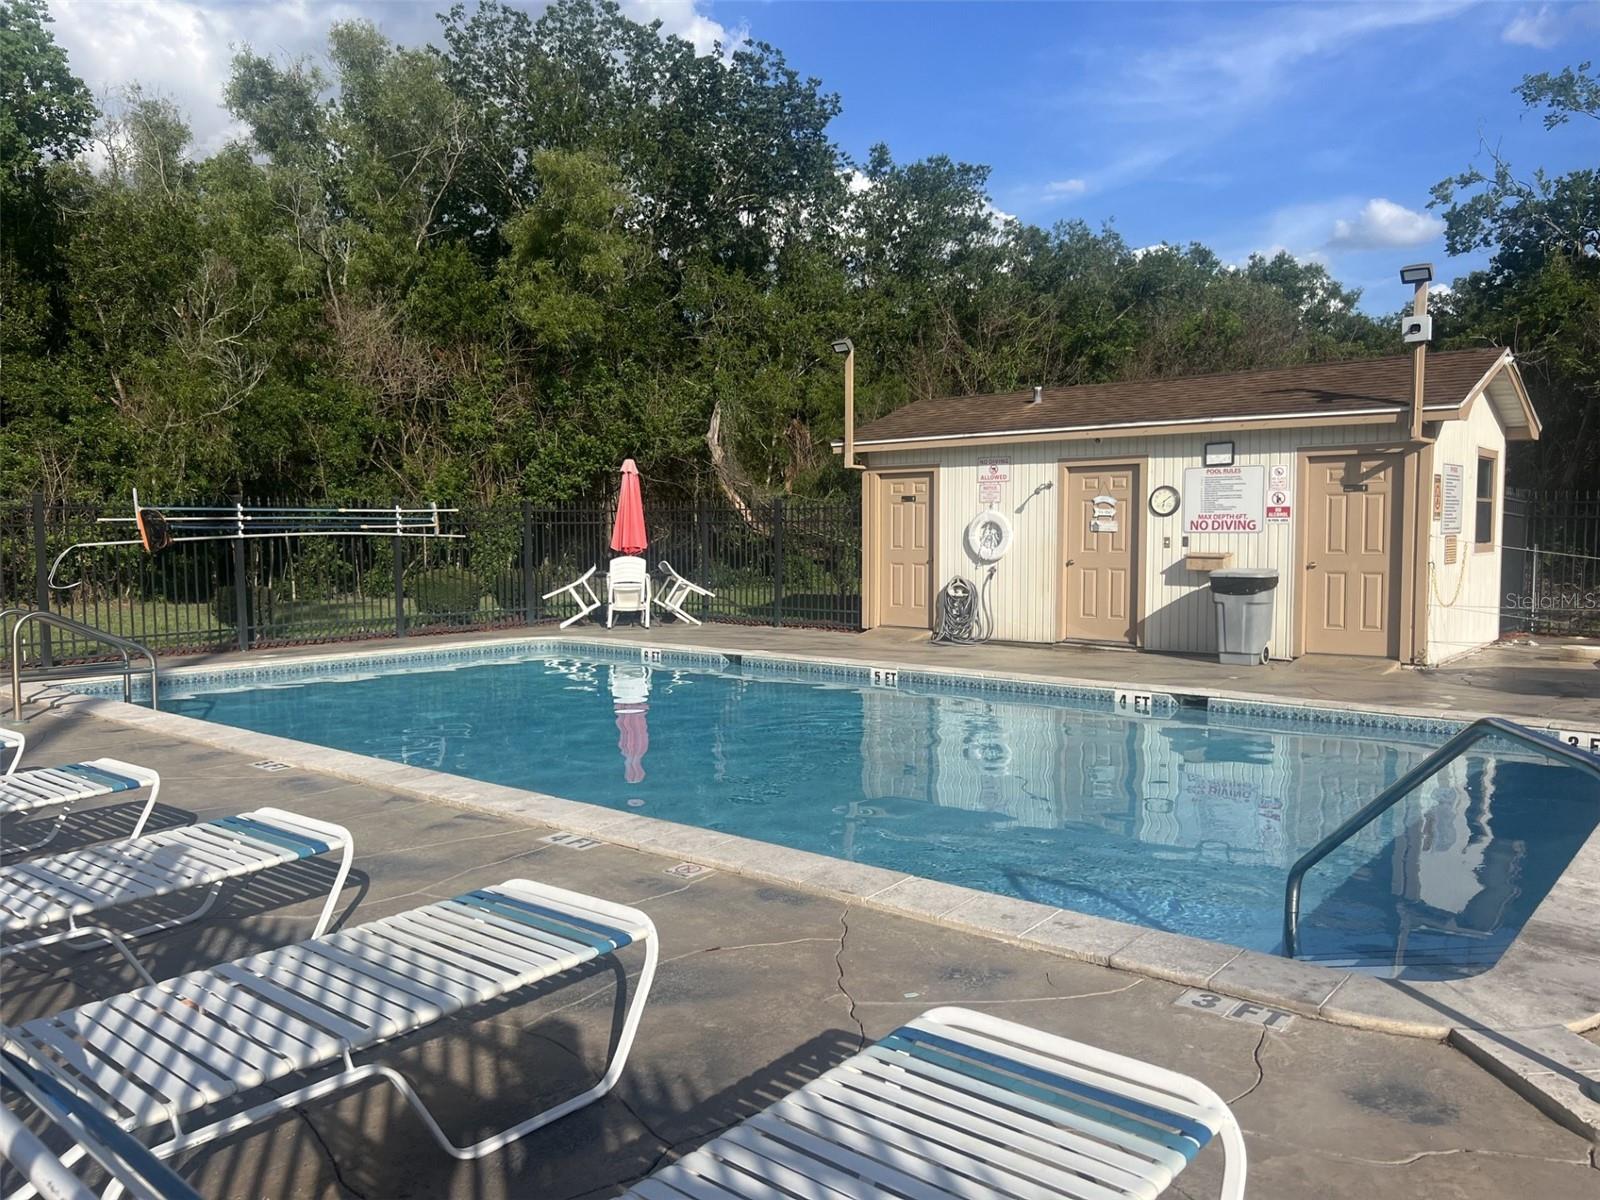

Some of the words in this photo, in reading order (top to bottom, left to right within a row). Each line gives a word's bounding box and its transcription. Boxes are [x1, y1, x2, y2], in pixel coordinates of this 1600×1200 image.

[1190, 520, 1208, 530] NO
[1212, 520, 1256, 530] DIVING
[565, 838, 602, 848] FT
[1192, 994, 1222, 1008] 3
[1232, 1003, 1291, 1025] FT
